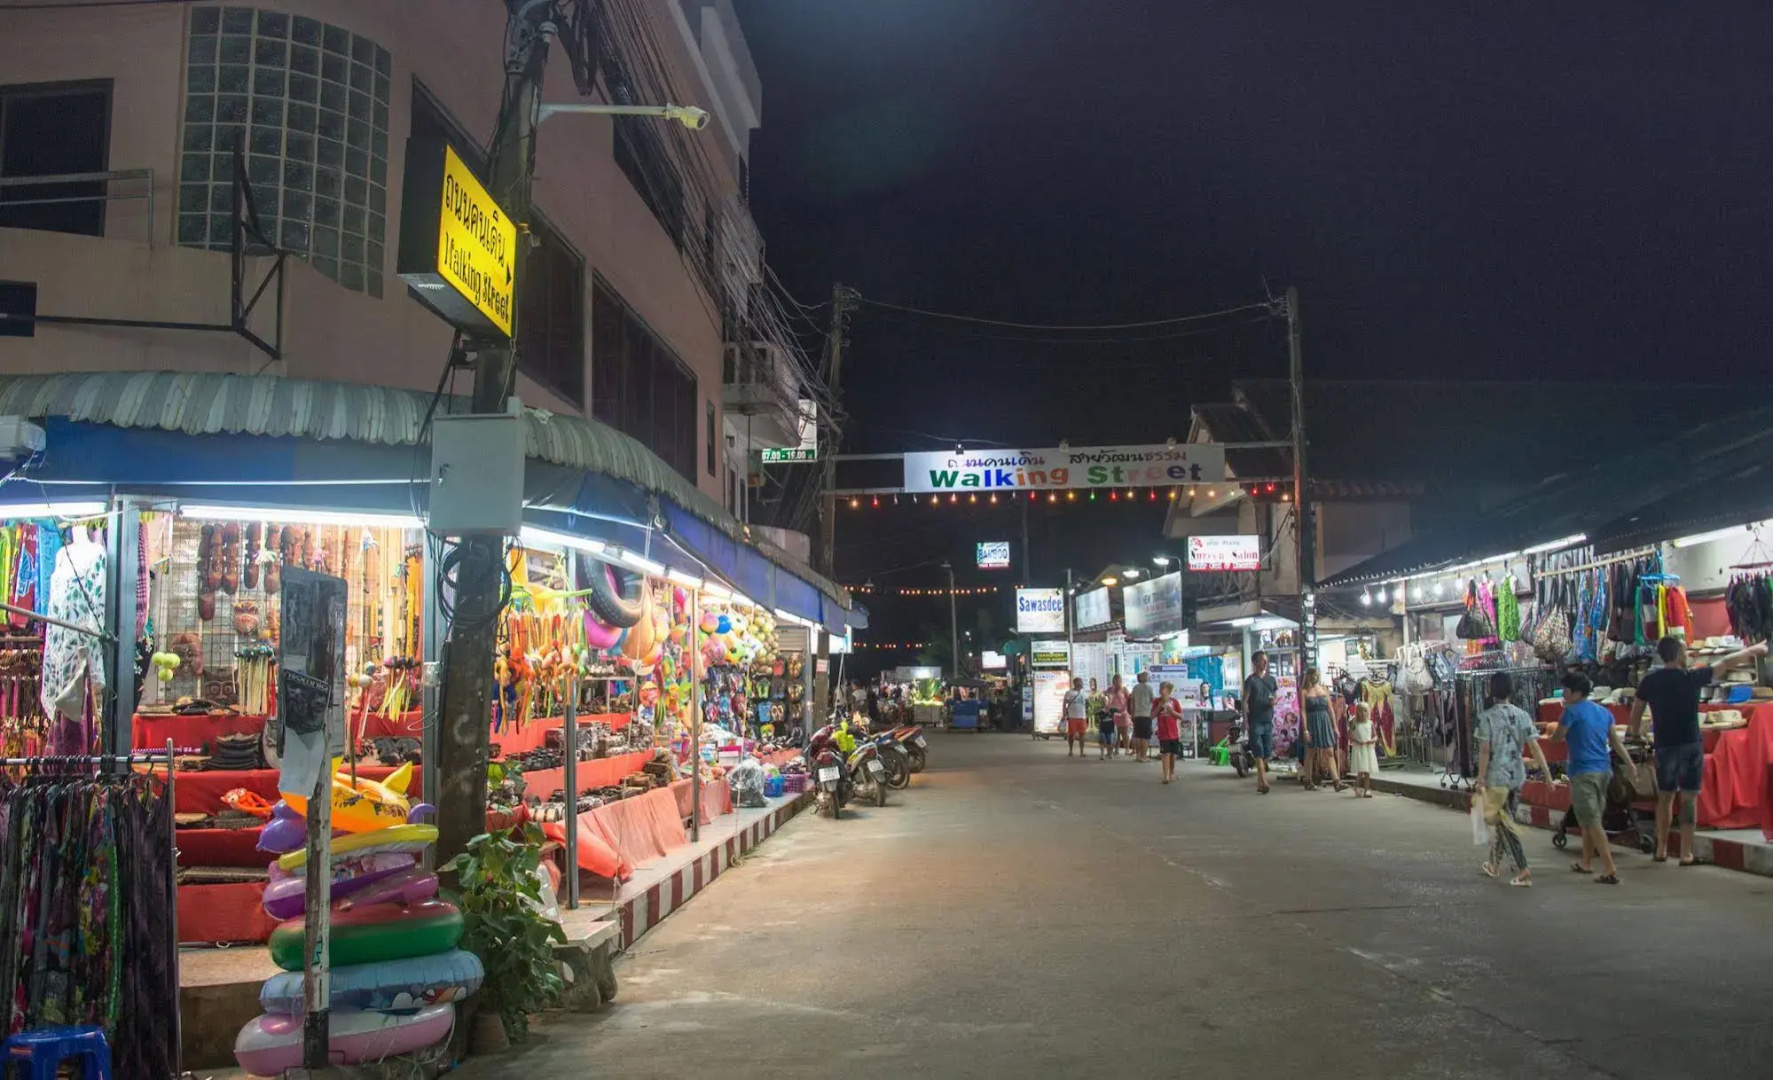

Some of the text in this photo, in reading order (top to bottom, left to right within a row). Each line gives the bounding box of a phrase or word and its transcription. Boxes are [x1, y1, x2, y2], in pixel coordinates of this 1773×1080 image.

[446, 174, 506, 267] ถนนคนเดิน
[483, 271, 510, 324] Street
[1069, 449, 1187, 464] สายวัฒนธรรม
[929, 463, 1202, 488] Walking Street
[1019, 596, 1063, 612] Sawasdee
